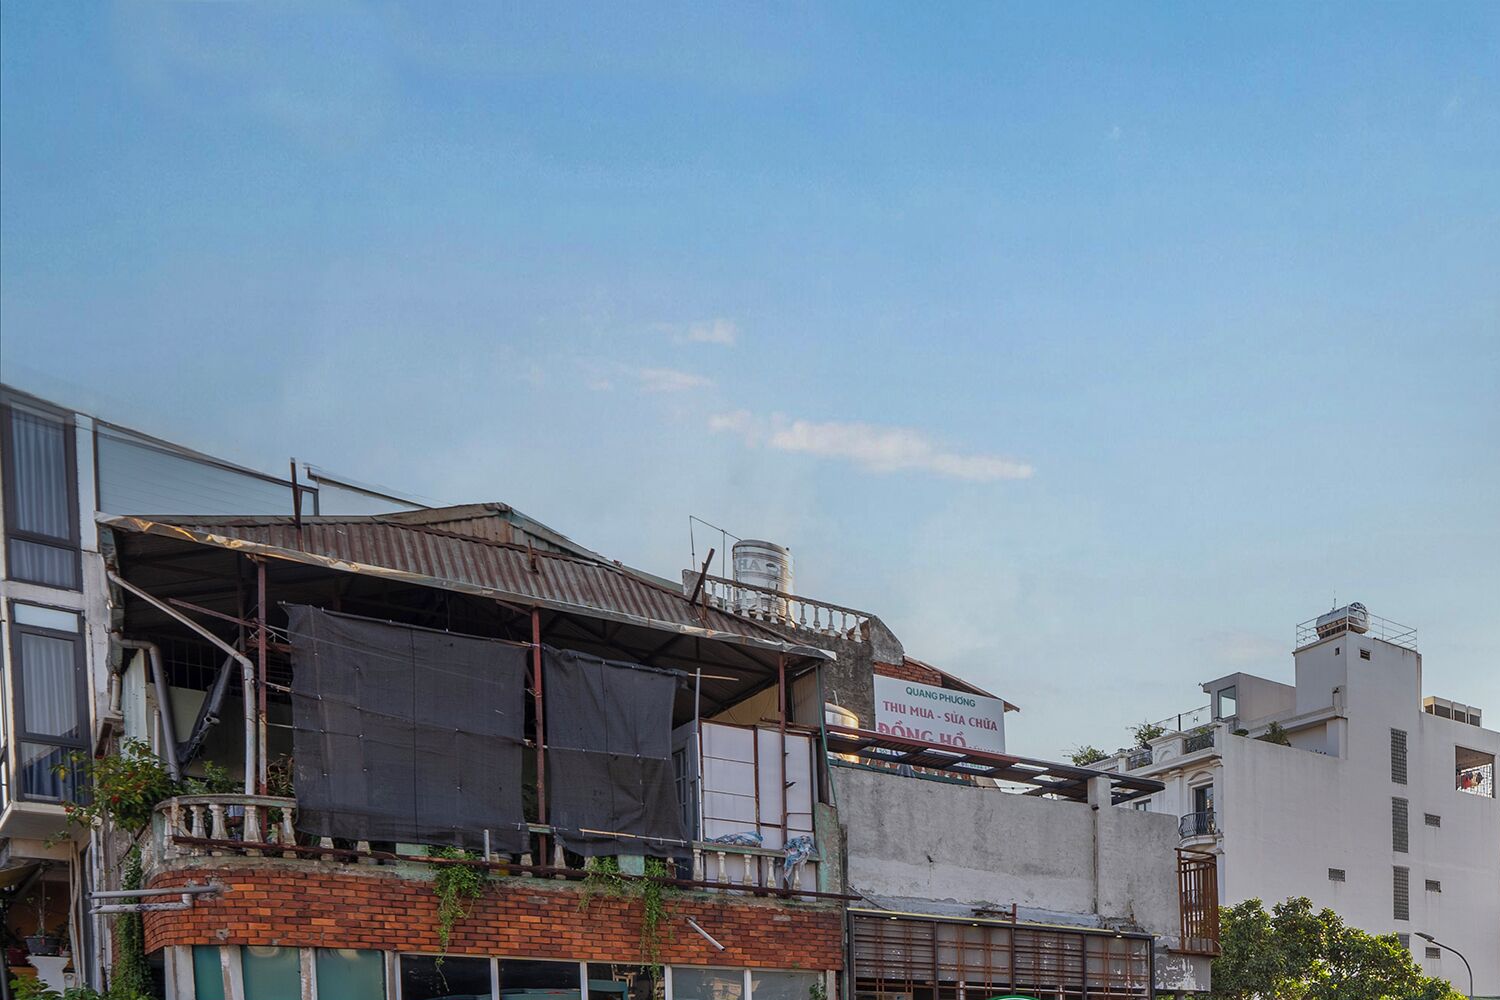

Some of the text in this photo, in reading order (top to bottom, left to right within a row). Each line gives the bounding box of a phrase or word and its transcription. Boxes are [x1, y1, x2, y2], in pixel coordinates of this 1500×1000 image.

[905, 686, 976, 708] QUANG PHƯƠNG
[883, 700, 906, 713] THU
[909, 705, 935, 720] MUA
